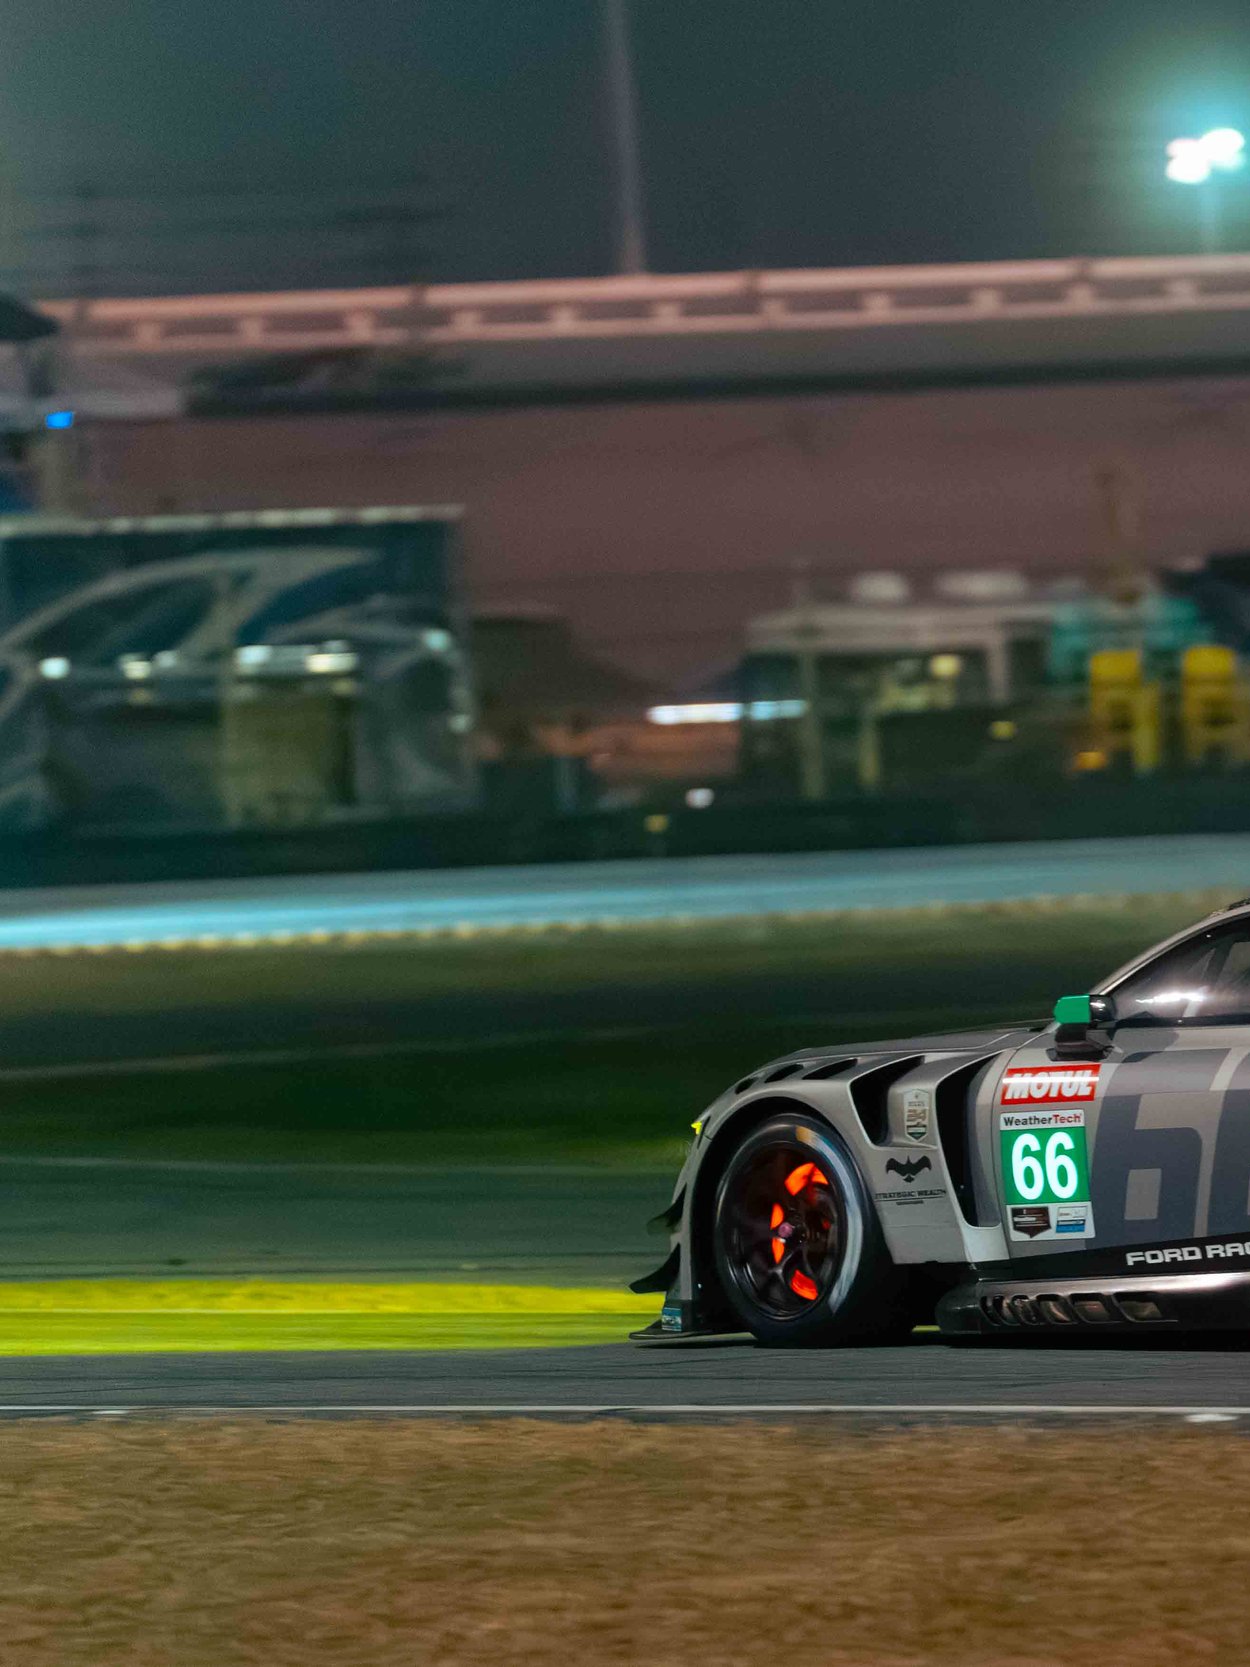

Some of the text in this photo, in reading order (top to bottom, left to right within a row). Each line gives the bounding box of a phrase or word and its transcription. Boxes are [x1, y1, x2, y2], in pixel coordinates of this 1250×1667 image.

[1004, 1070, 1093, 1100] MOTUL
[1003, 1113, 1082, 1126] WeatherTech
[1011, 1131, 1079, 1200] 66
[1126, 1247, 1203, 1266] FORD
